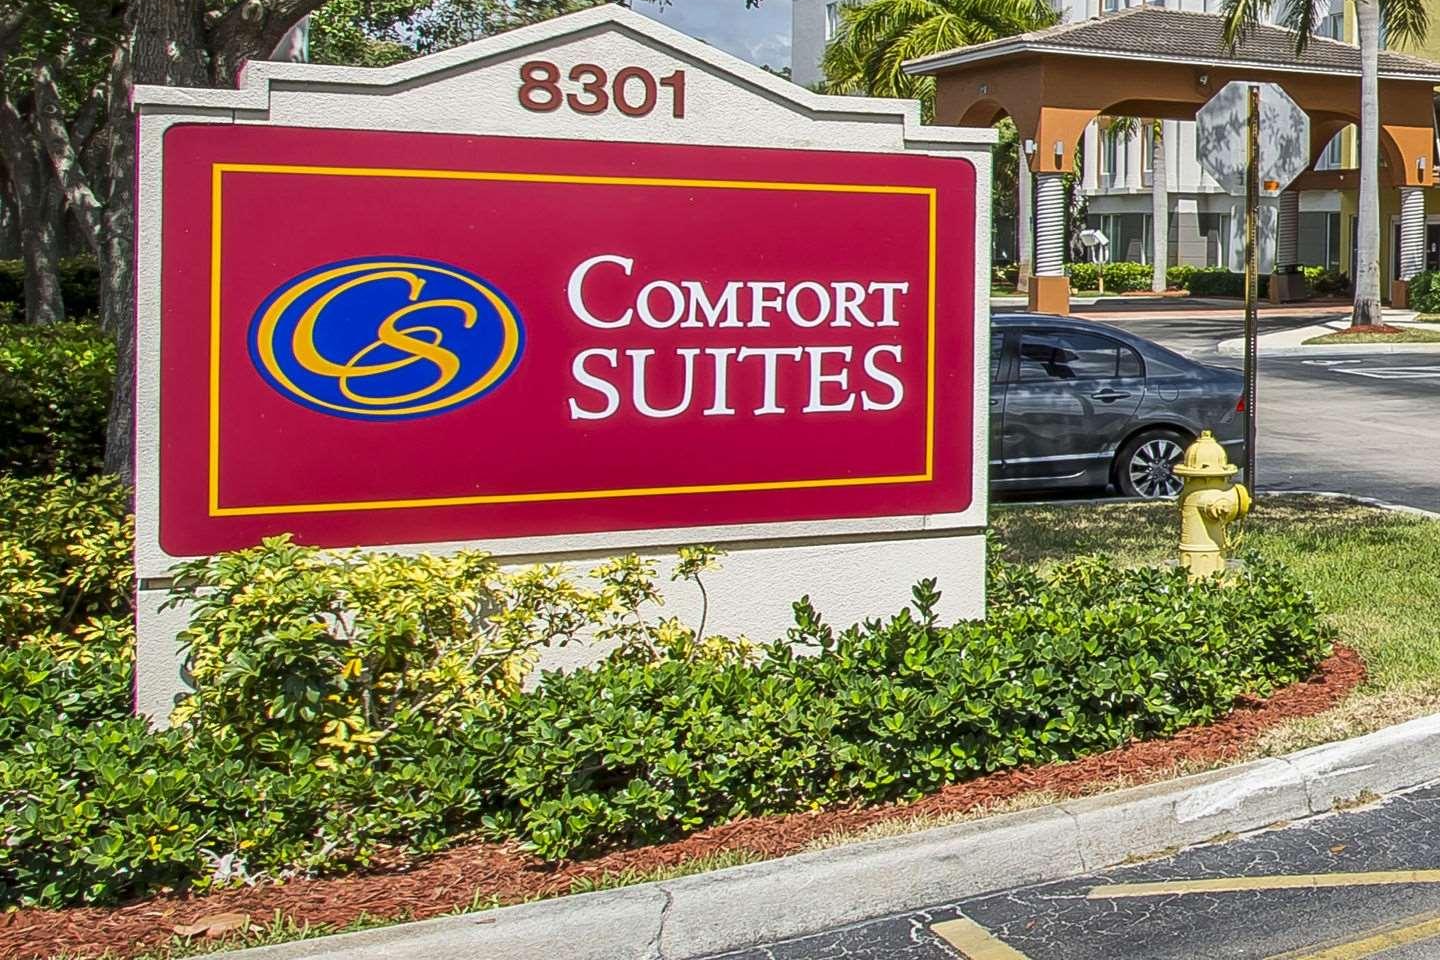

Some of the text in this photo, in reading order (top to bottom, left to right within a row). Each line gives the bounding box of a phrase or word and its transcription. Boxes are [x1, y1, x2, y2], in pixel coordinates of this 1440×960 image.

[518, 60, 686, 120] 8301
[567, 254, 909, 330] COMFORT
[568, 344, 904, 421] SUITES
